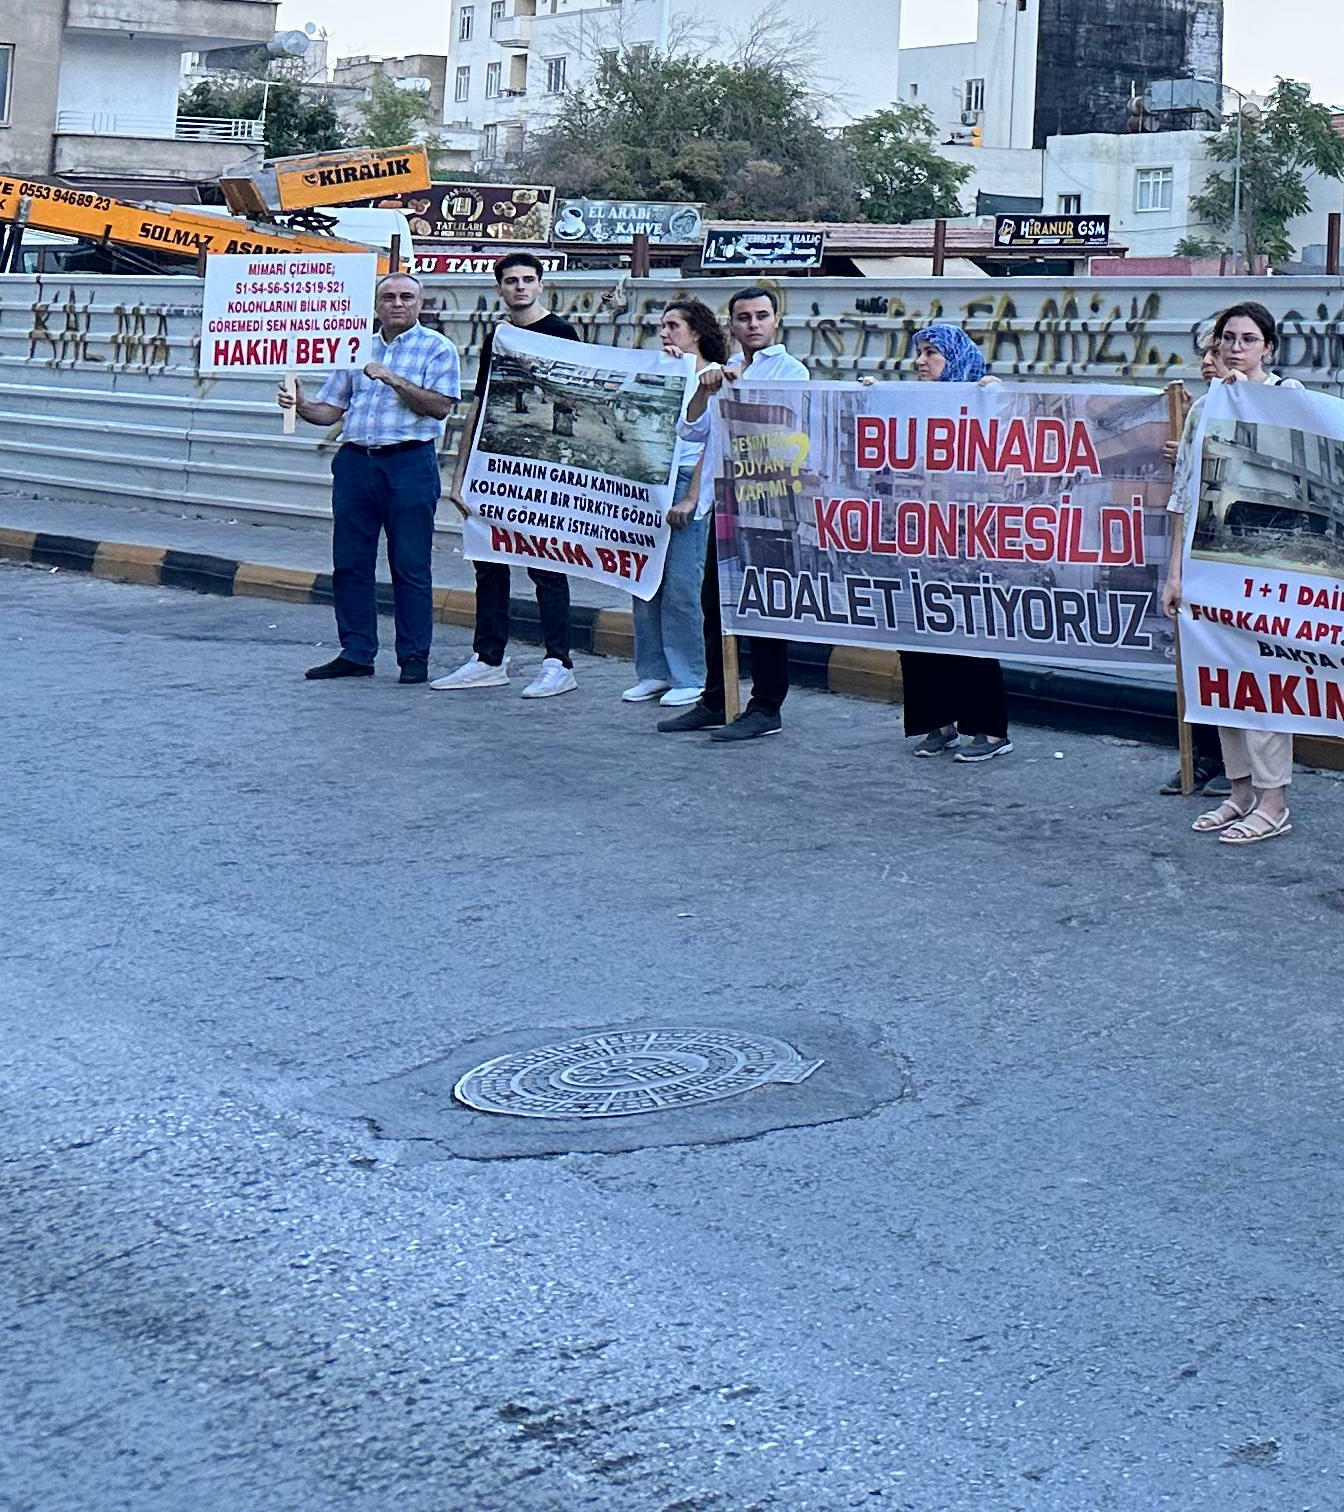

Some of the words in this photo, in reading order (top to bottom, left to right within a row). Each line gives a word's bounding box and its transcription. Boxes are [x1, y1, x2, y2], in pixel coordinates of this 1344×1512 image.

[19, 182, 51, 200] 0553
[588, 207, 605, 218] EL
[615, 222, 663, 235] KAHVE
[1077, 221, 1106, 235] GSM
[227, 299, 297, 314] KOLONLARINI
[208, 316, 264, 333] GÖREMEDİ
[266, 318, 287, 332] SEN
[290, 318, 320, 332] NASIL
[323, 315, 368, 331] GÖRDÜN
[296, 337, 341, 364] BEY
[347, 336, 361, 364] ?
[856, 416, 917, 472] BU
[926, 406, 1103, 477] BİNADA
[550, 468, 589, 488] GARAJ
[734, 458, 785, 478] DUYAN
[735, 481, 765, 502] VAR
[768, 479, 788, 498] MI
[469, 479, 547, 503] KOLONLARI
[621, 504, 662, 529] GÖRDÜ
[479, 503, 504, 520] SEN
[507, 506, 565, 531] GÖRMEK
[814, 497, 959, 558] KOLON
[965, 494, 1147, 567] KESİLDİ
[595, 546, 649, 582] BEY
[737, 566, 903, 630] ADALET
[911, 569, 1154, 650] İSTİYORUZ
[1189, 603, 1291, 637] FURKAN
[1257, 639, 1338, 670] BAKTA
